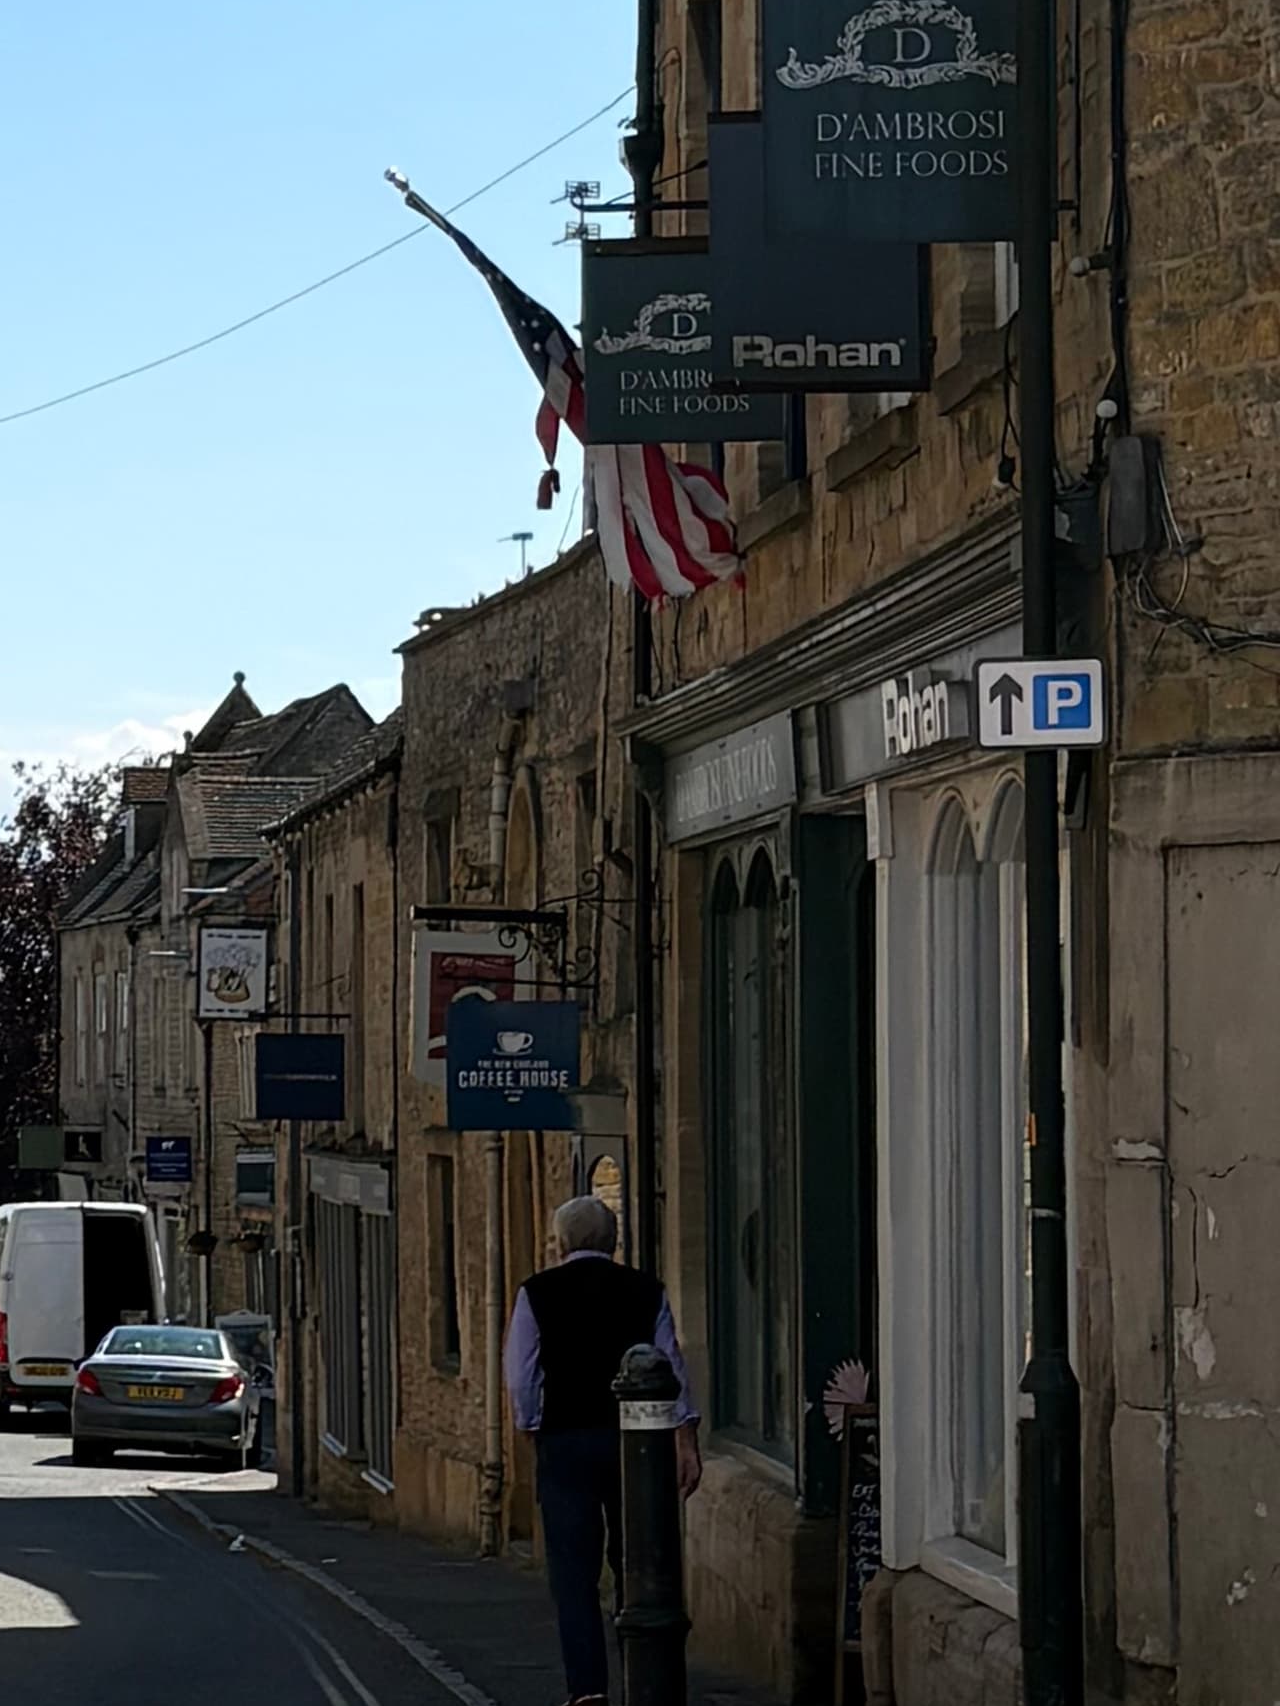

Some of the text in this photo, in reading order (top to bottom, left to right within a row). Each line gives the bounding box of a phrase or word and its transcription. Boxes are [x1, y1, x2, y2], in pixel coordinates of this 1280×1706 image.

[893, 27, 932, 63] D
[816, 109, 1005, 142] D'AMBROSI
[815, 149, 1009, 179] FINE FOODS
[672, 312, 698, 338] D
[619, 369, 715, 391] D'AMBR
[619, 394, 751, 416] FINE FOODS
[881, 670, 950, 759] Rohan
[1047, 680, 1083, 726] P
[458, 1069, 569, 1089] COFFEE HOUSE
